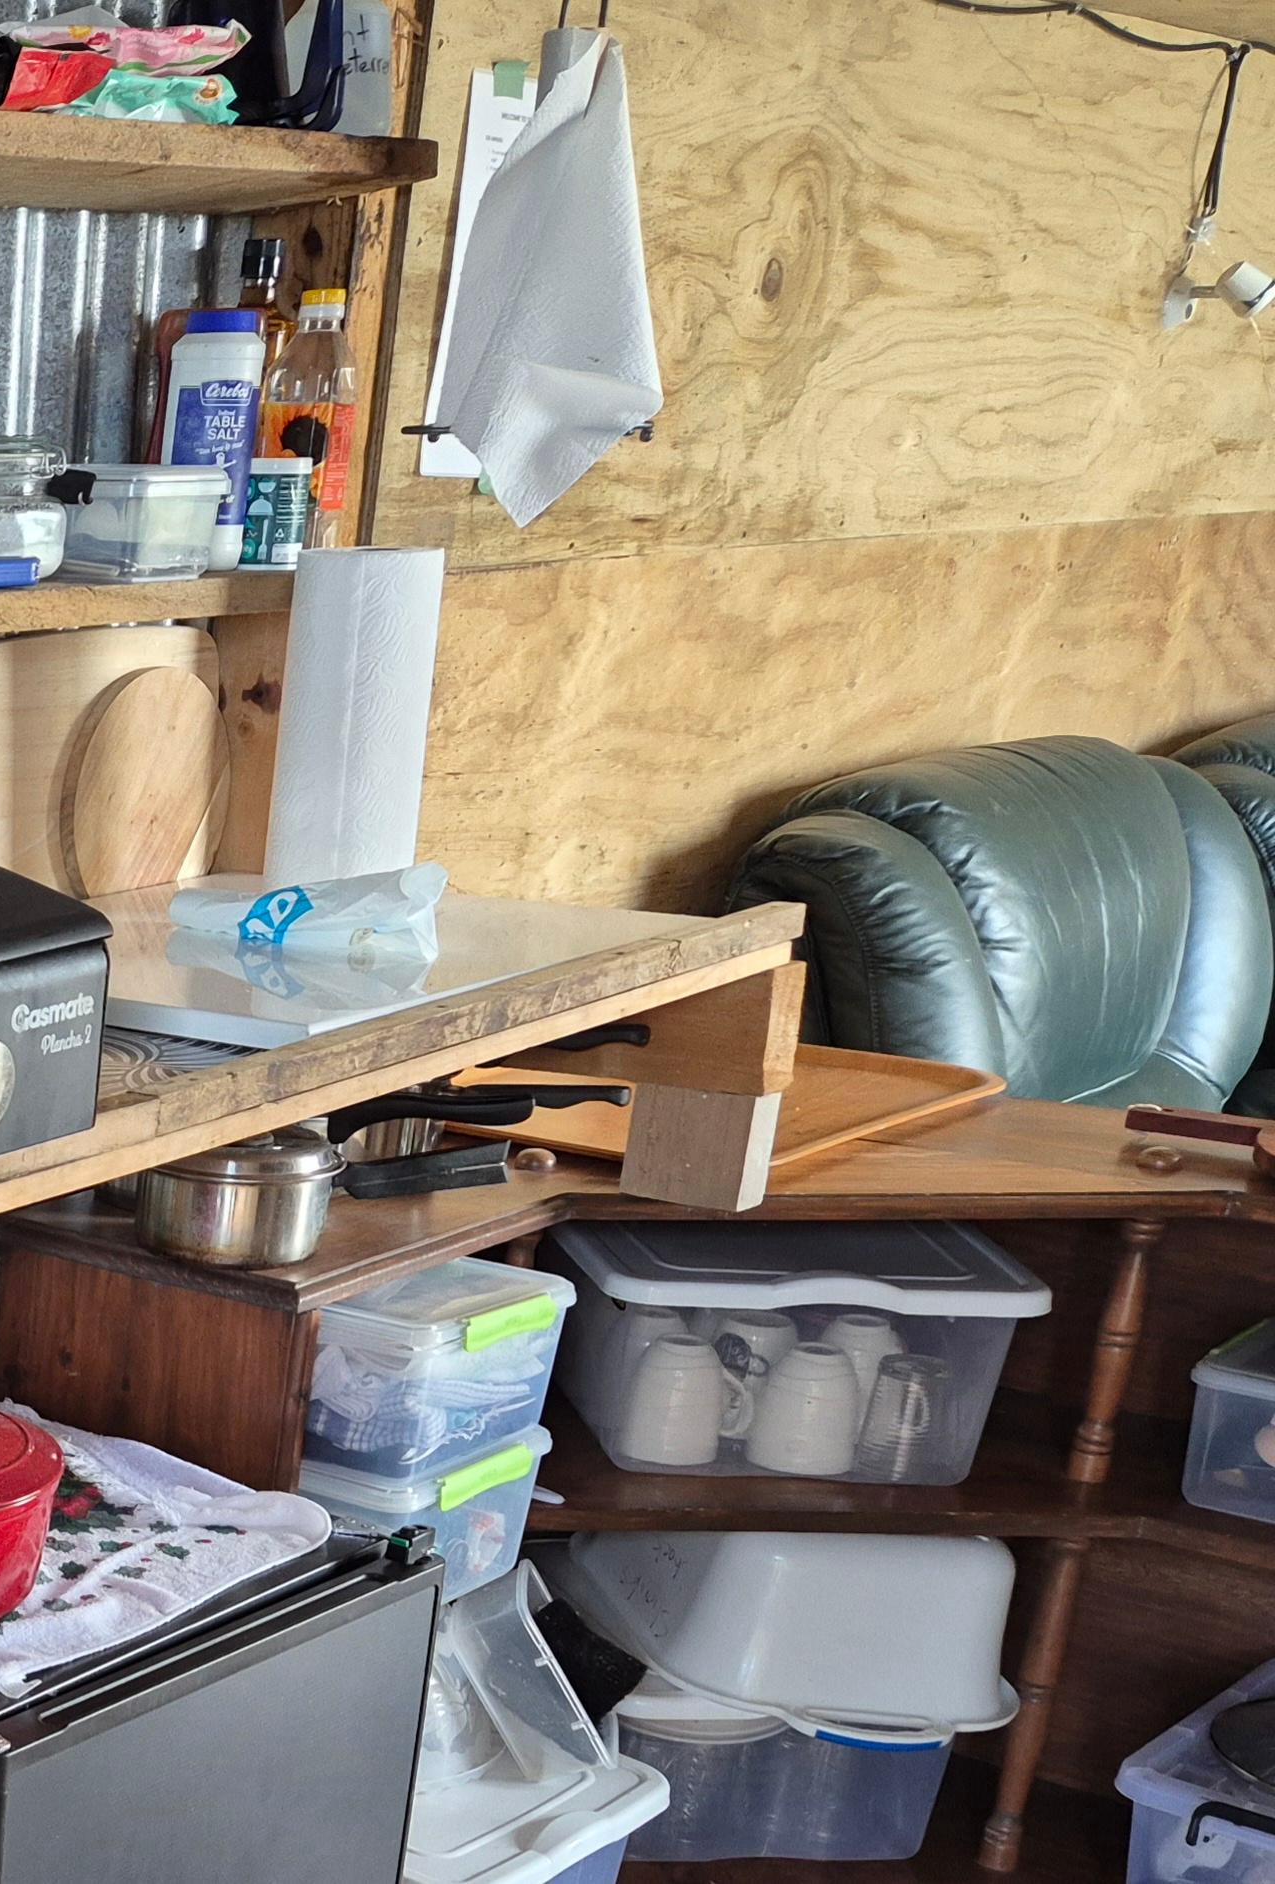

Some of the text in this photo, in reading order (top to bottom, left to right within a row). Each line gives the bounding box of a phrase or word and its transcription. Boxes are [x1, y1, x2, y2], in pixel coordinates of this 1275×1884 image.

[205, 382, 250, 399] Cerebos
[204, 415, 247, 428] TABLE
[207, 428, 241, 440] SALT
[11, 992, 95, 1034] Gasmate
[41, 1023, 93, 1056] Plancha 2
